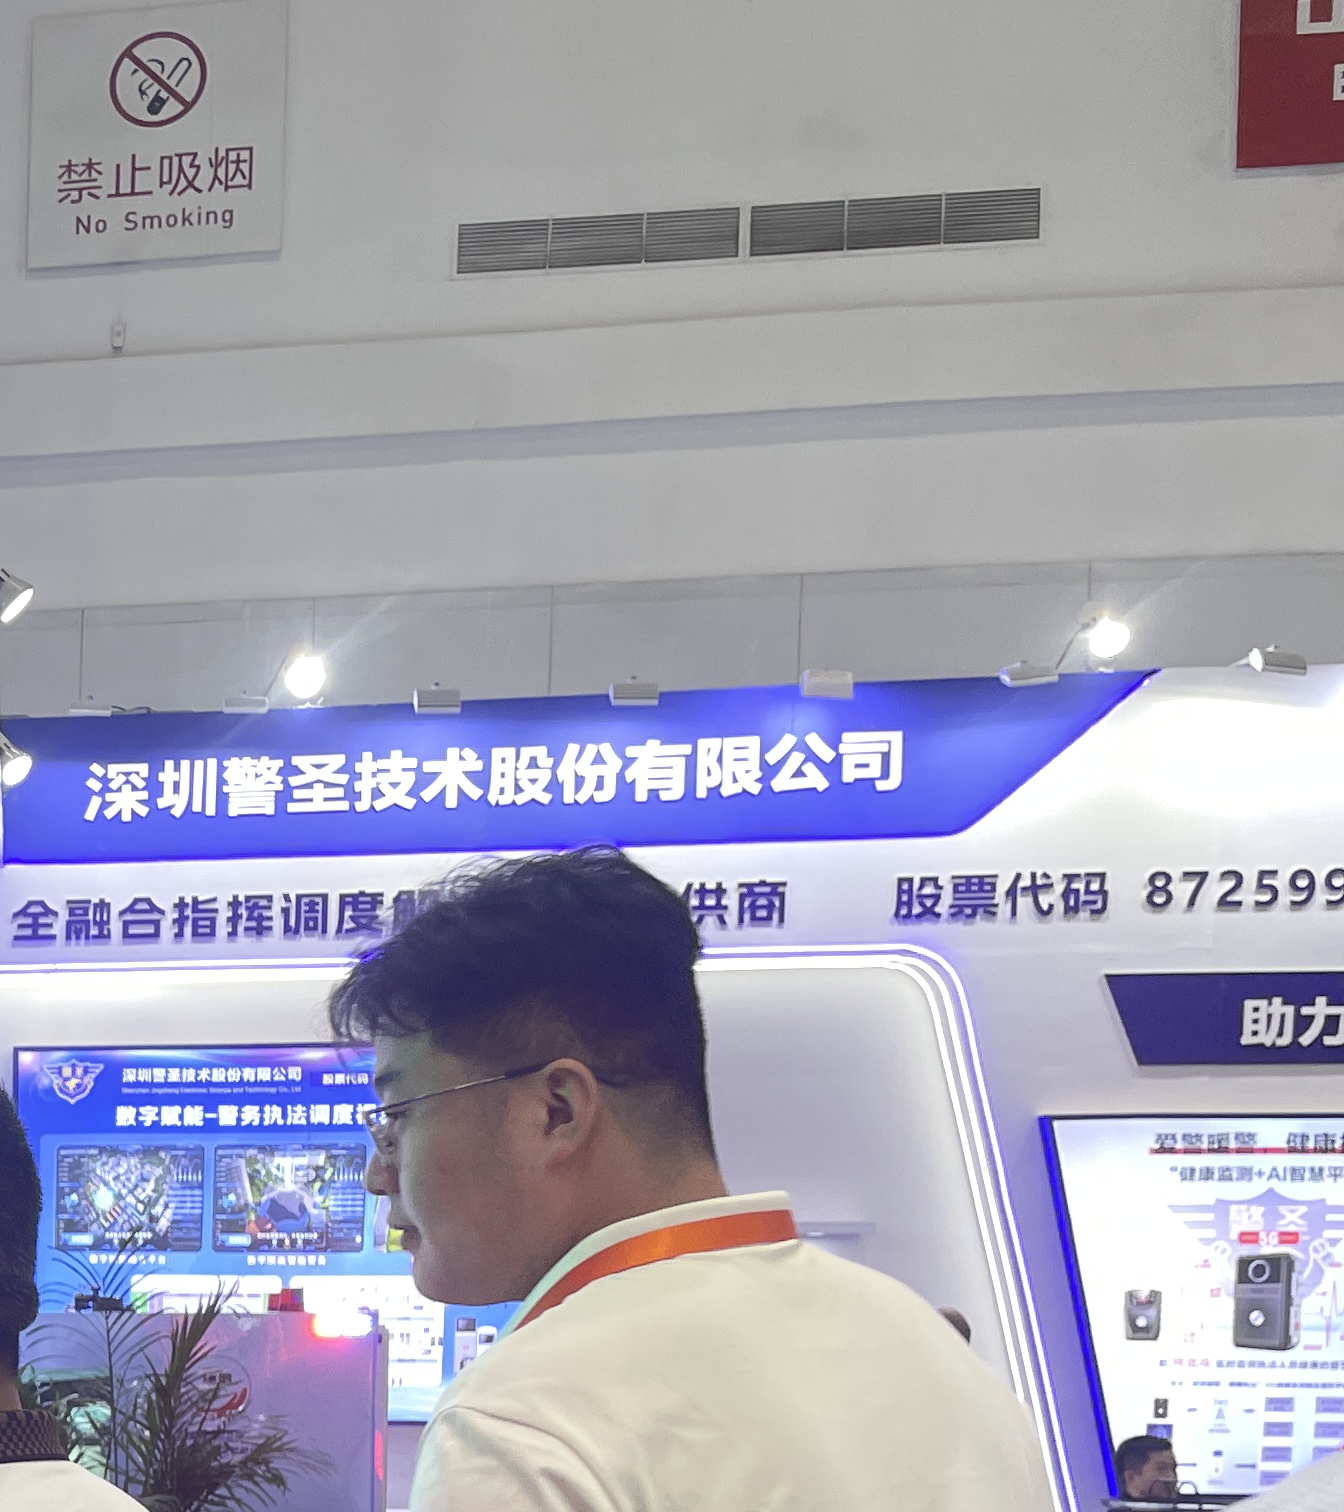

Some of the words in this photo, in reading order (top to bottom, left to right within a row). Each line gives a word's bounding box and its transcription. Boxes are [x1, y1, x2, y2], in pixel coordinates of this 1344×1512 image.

[57, 146, 254, 204] 禁止吸烟
[75, 215, 107, 235] No
[124, 206, 234, 231] Smoking
[83, 730, 905, 823] 深圳警圣技术股份有限公司
[893, 871, 1109, 918] 股票代码
[1146, 869, 1344, 908] 872599
[1240, 996, 1344, 1047] 助力
[122, 1067, 302, 1083] 深圳警圣技术股份有限公司
[1286, 1132, 1344, 1153] 健康
